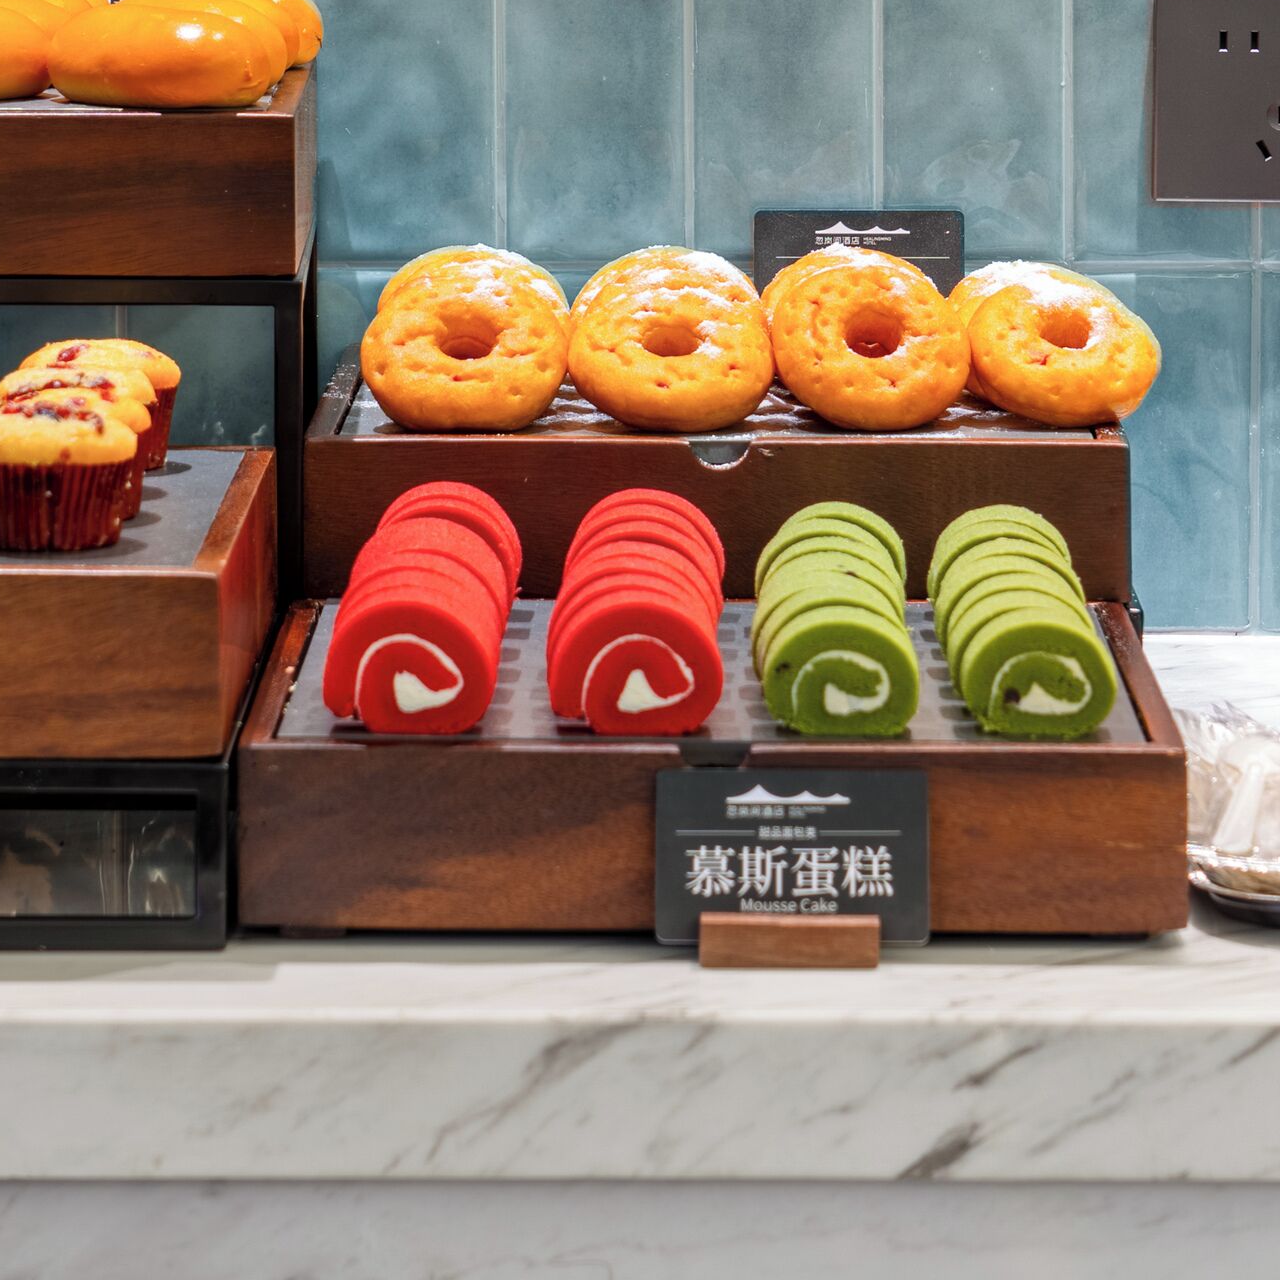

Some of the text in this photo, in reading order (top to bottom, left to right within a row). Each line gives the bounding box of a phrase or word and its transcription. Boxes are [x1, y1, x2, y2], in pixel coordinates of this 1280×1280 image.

[685, 845, 895, 898] 慕斯蛋糕
[740, 898, 838, 912] Mousse Cake
